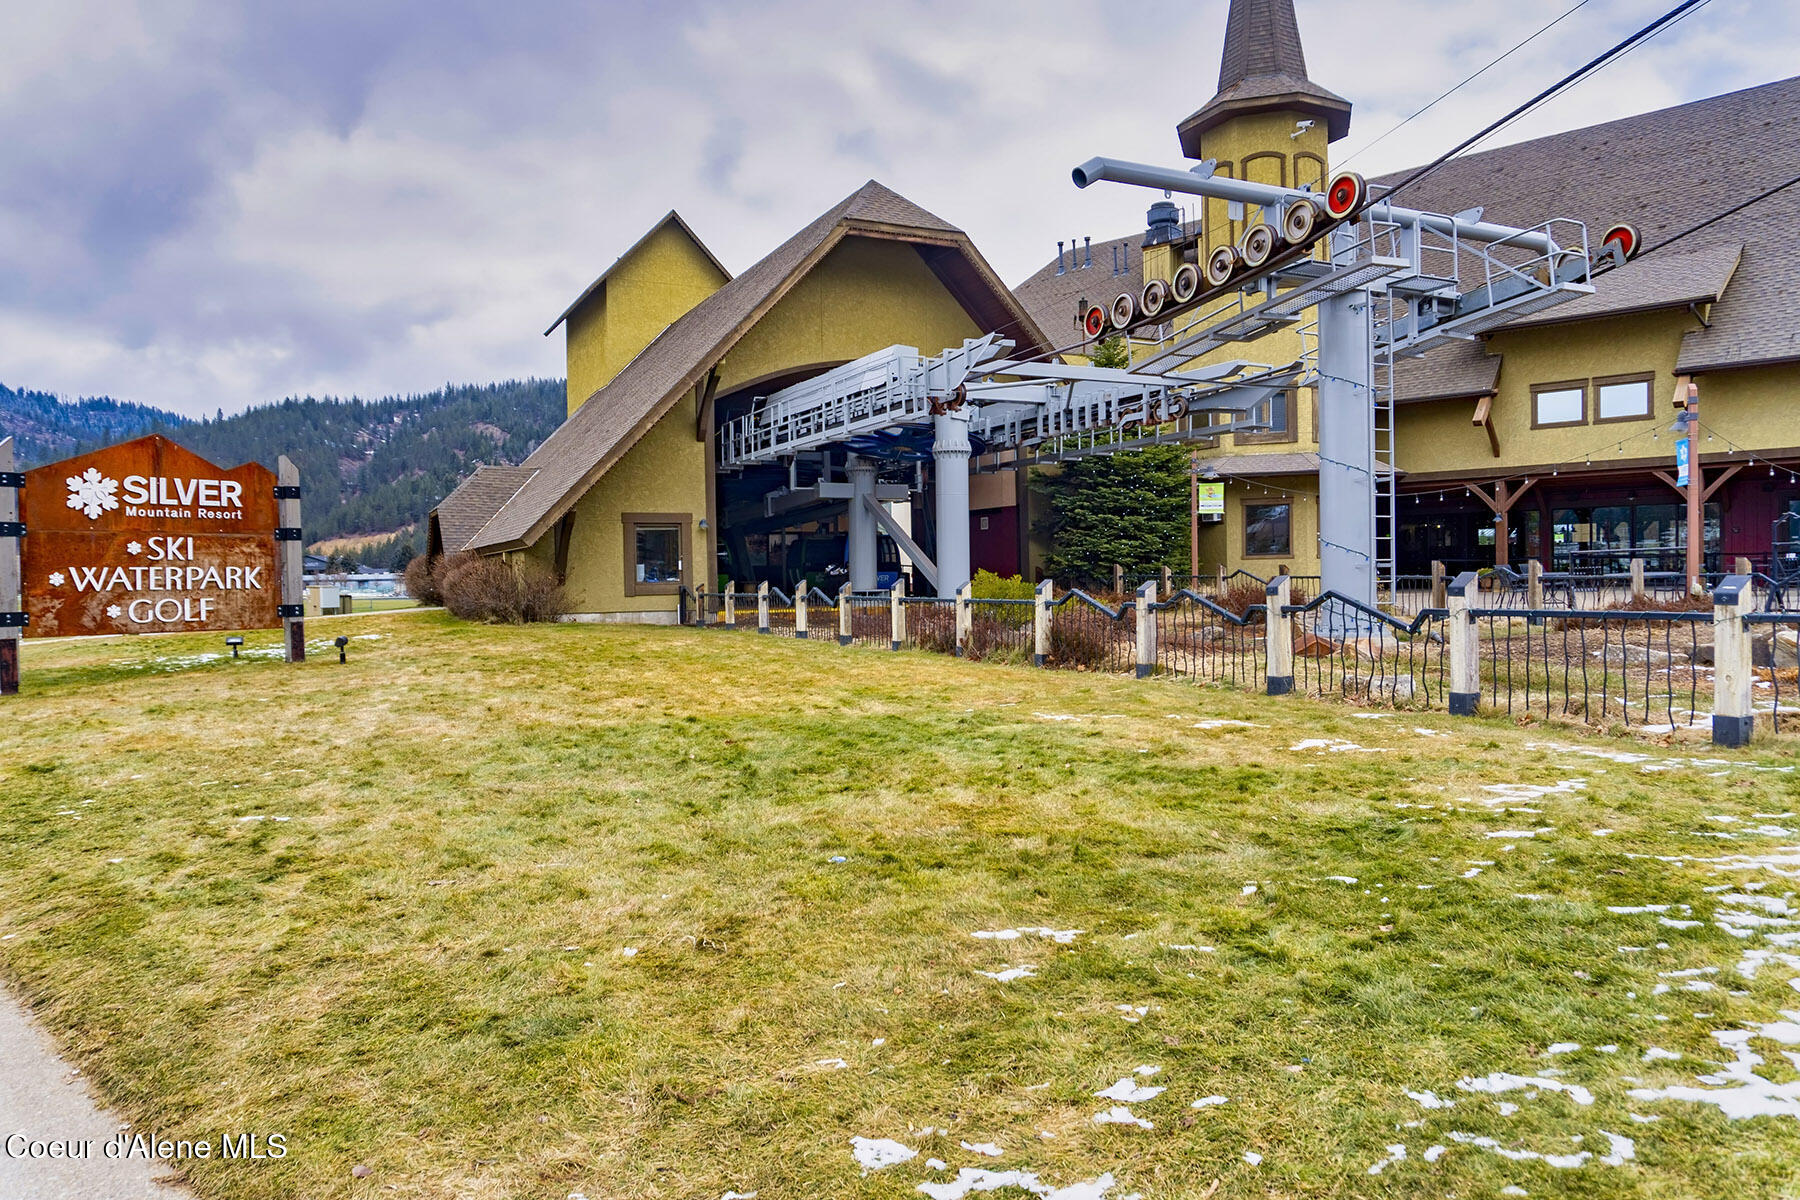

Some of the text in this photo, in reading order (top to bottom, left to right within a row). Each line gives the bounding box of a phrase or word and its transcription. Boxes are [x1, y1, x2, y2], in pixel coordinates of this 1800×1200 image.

[122, 475, 243, 508] SILVER
[125, 506, 243, 520] Mountain Resort
[146, 536, 194, 561] SKI
[68, 566, 262, 592] WATERPARK
[128, 598, 215, 624] GOLF
